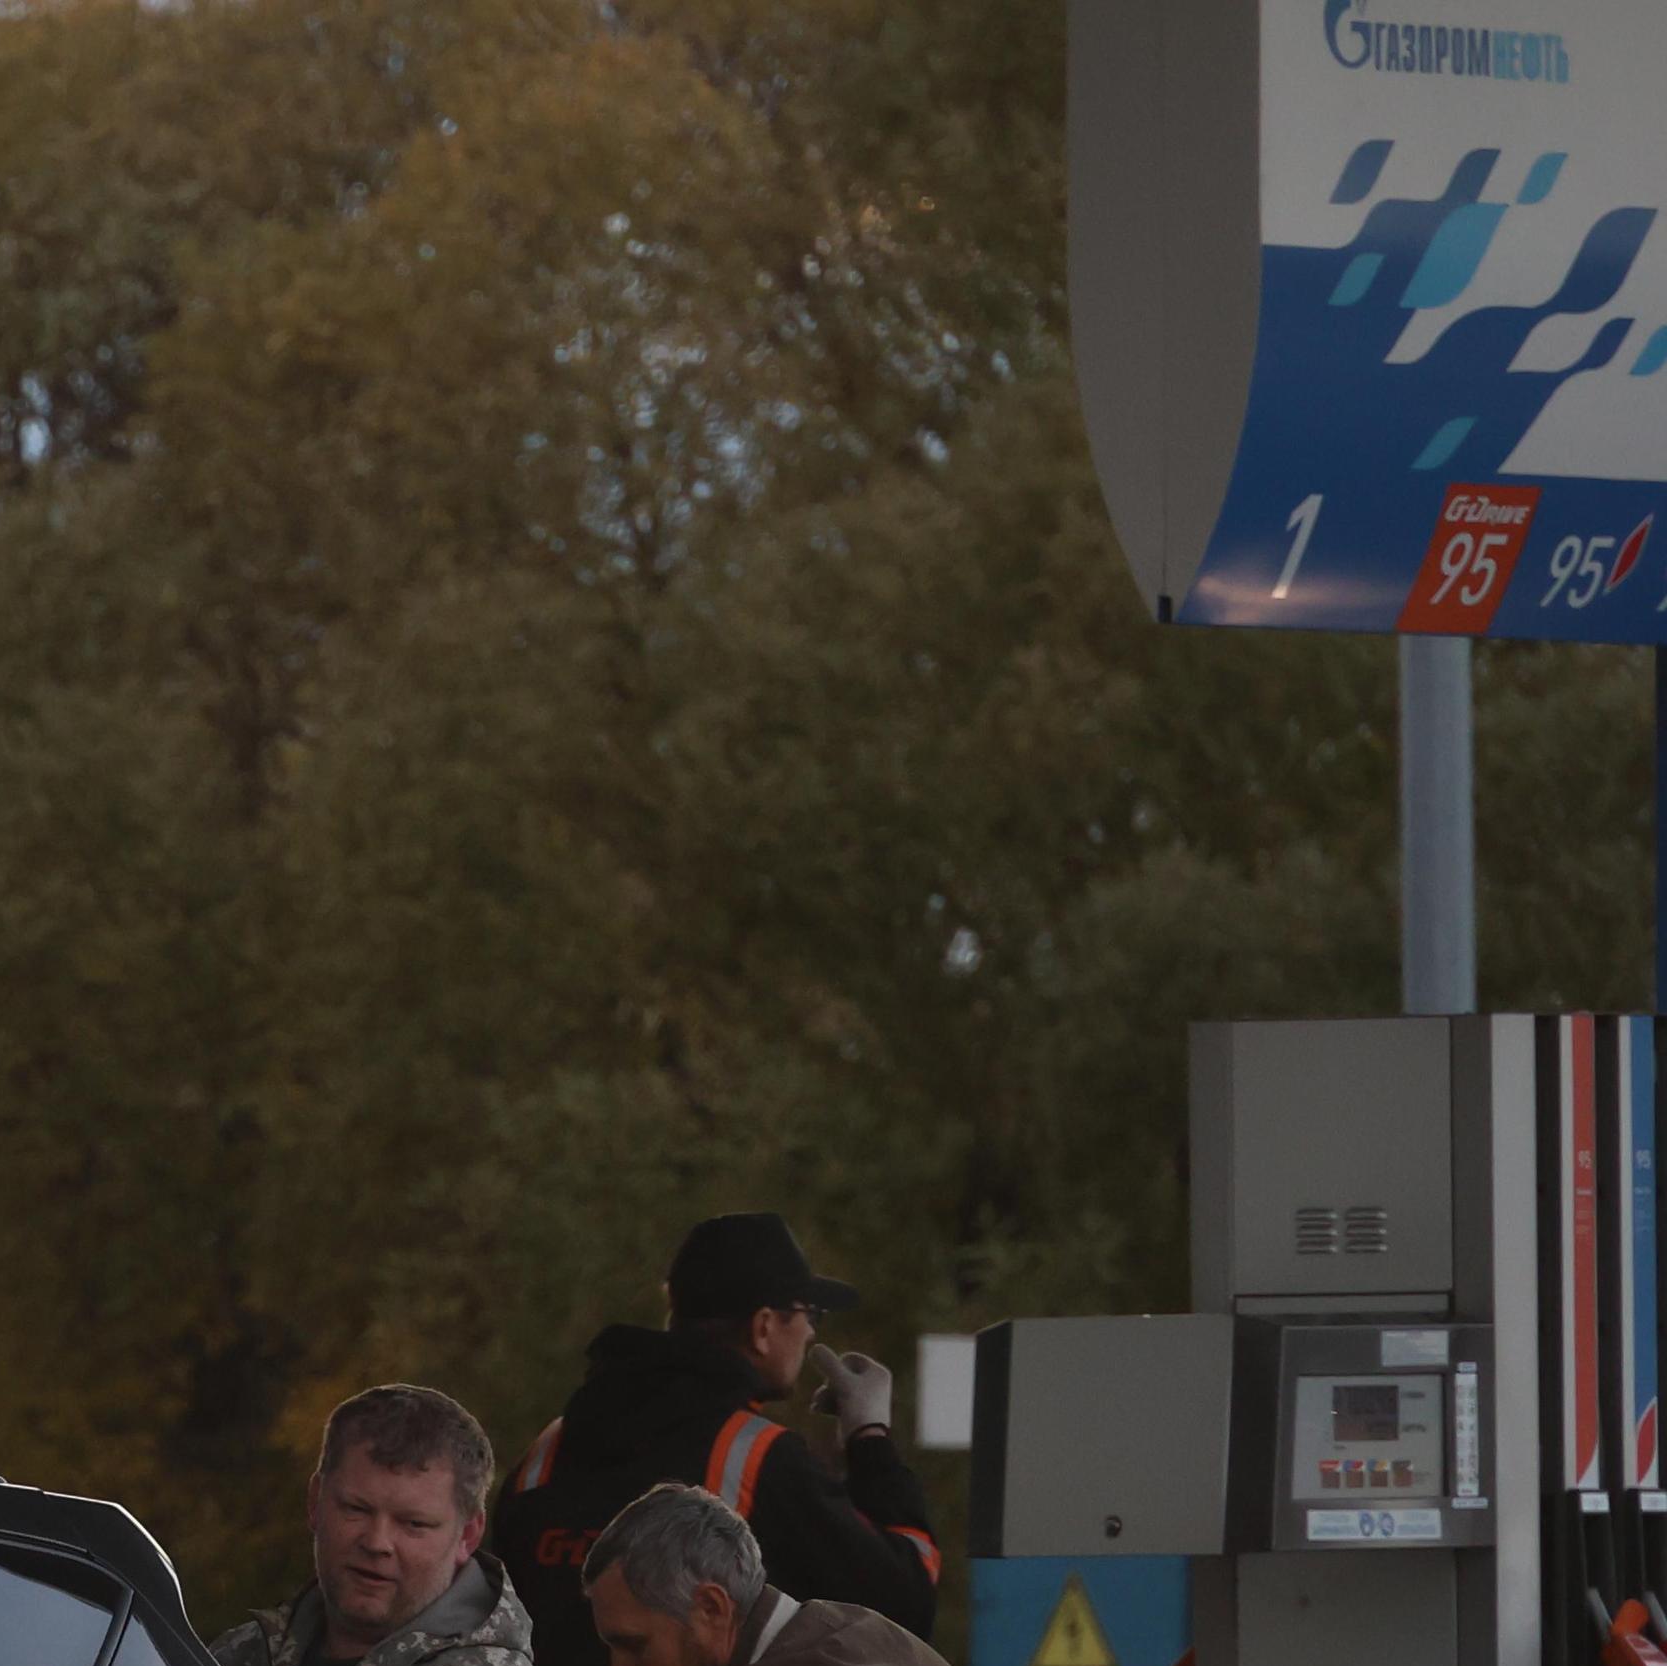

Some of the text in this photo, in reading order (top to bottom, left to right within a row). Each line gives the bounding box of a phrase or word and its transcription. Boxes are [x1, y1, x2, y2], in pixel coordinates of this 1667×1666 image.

[1272, 493, 1324, 600] 1
[1430, 531, 1616, 609] 95 95
